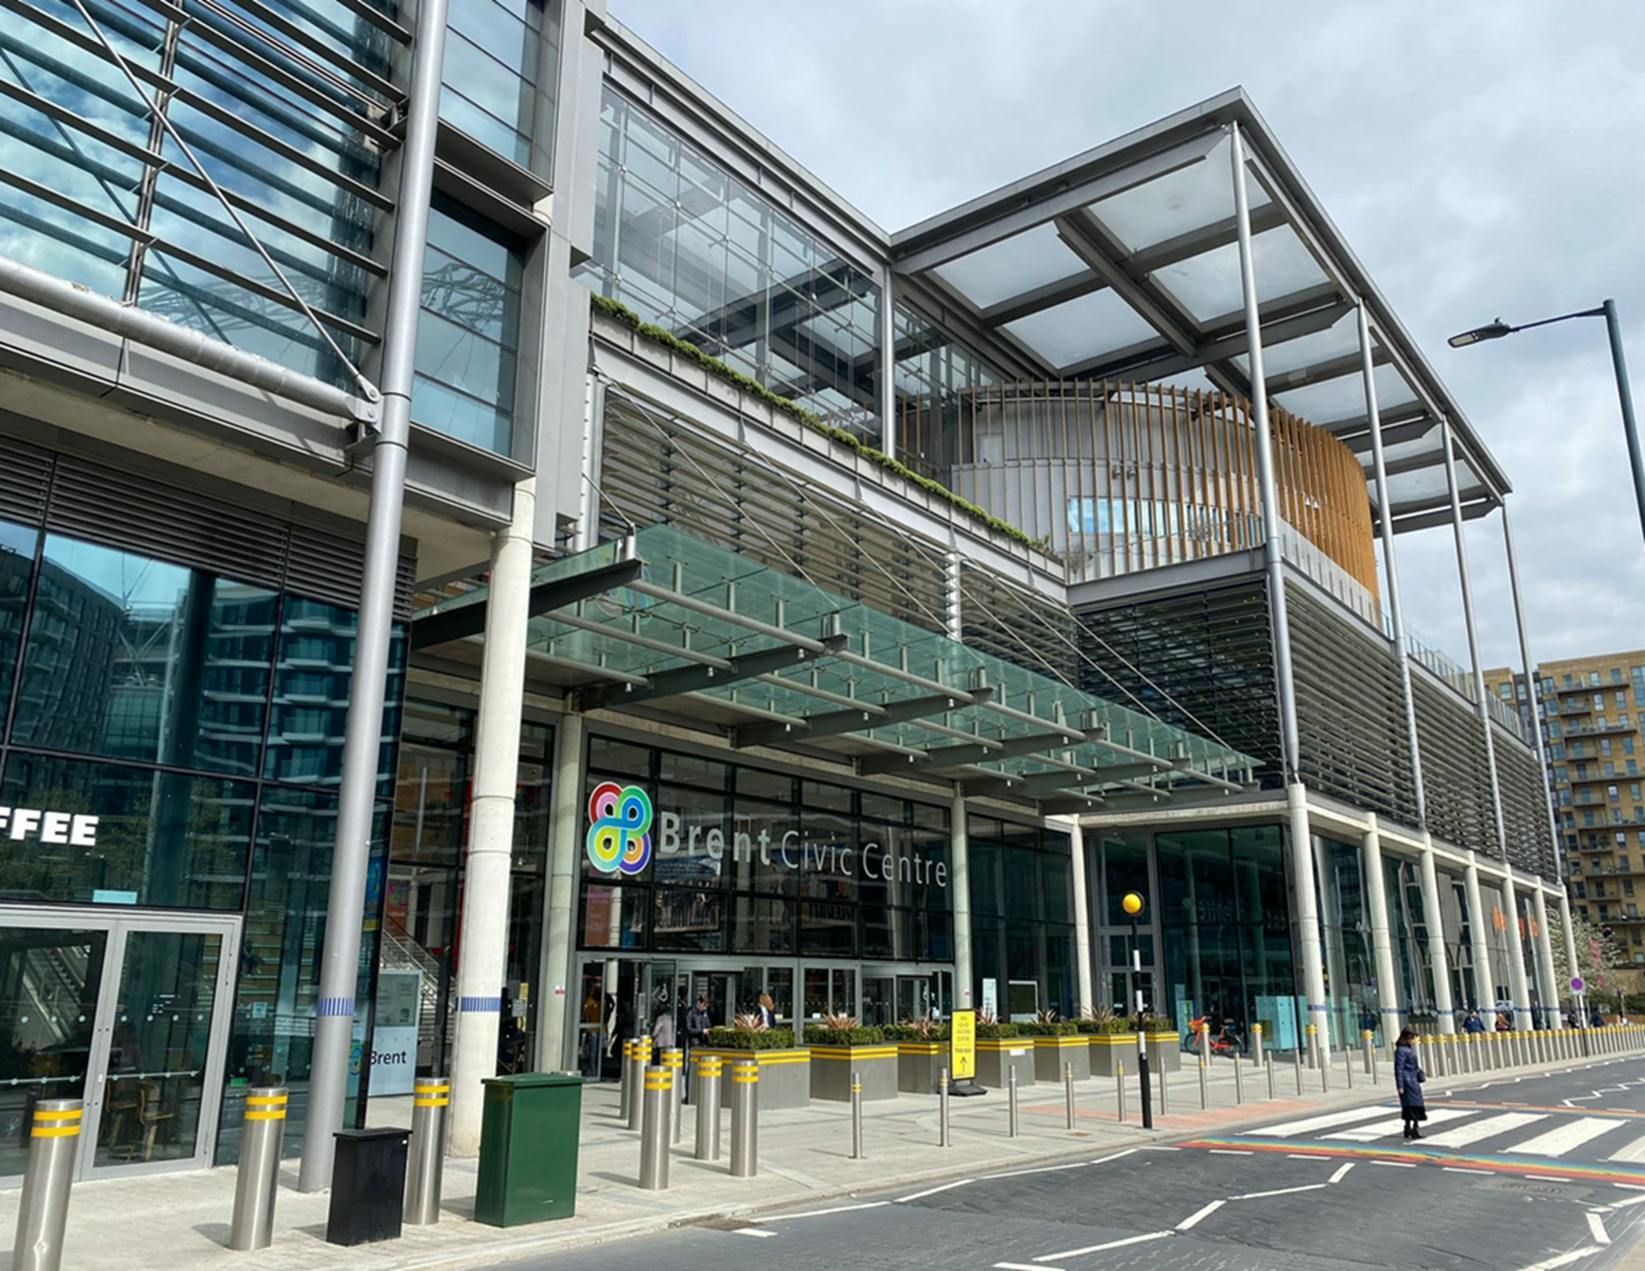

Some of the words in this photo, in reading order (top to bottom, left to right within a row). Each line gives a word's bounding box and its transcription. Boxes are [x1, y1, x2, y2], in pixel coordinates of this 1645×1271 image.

[660, 811, 771, 866] Brent
[781, 830, 853, 876] Civic
[862, 843, 947, 888] Centre
[370, 1050, 408, 1065] Brent
